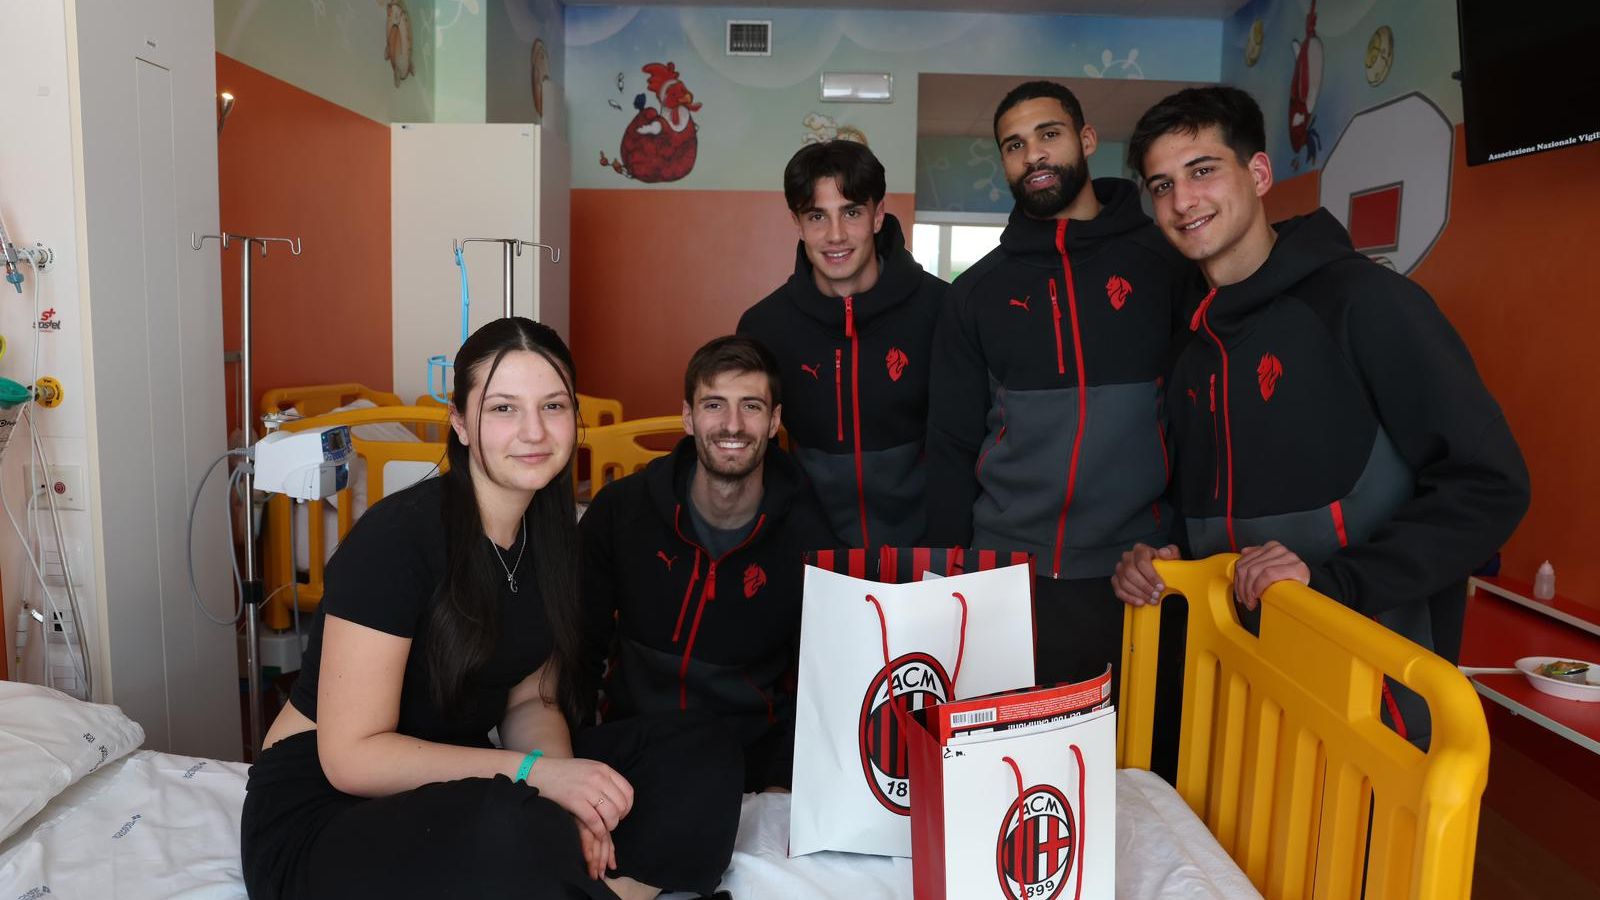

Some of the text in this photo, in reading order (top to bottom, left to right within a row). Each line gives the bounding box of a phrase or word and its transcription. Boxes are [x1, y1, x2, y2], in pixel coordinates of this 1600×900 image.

[1488, 146, 1536, 161] Associazione
[1537, 137, 1577, 151] Nazionale
[883, 667, 937, 699] ACM
[887, 780, 908, 798] 18
[1016, 795, 1060, 825] ACM
